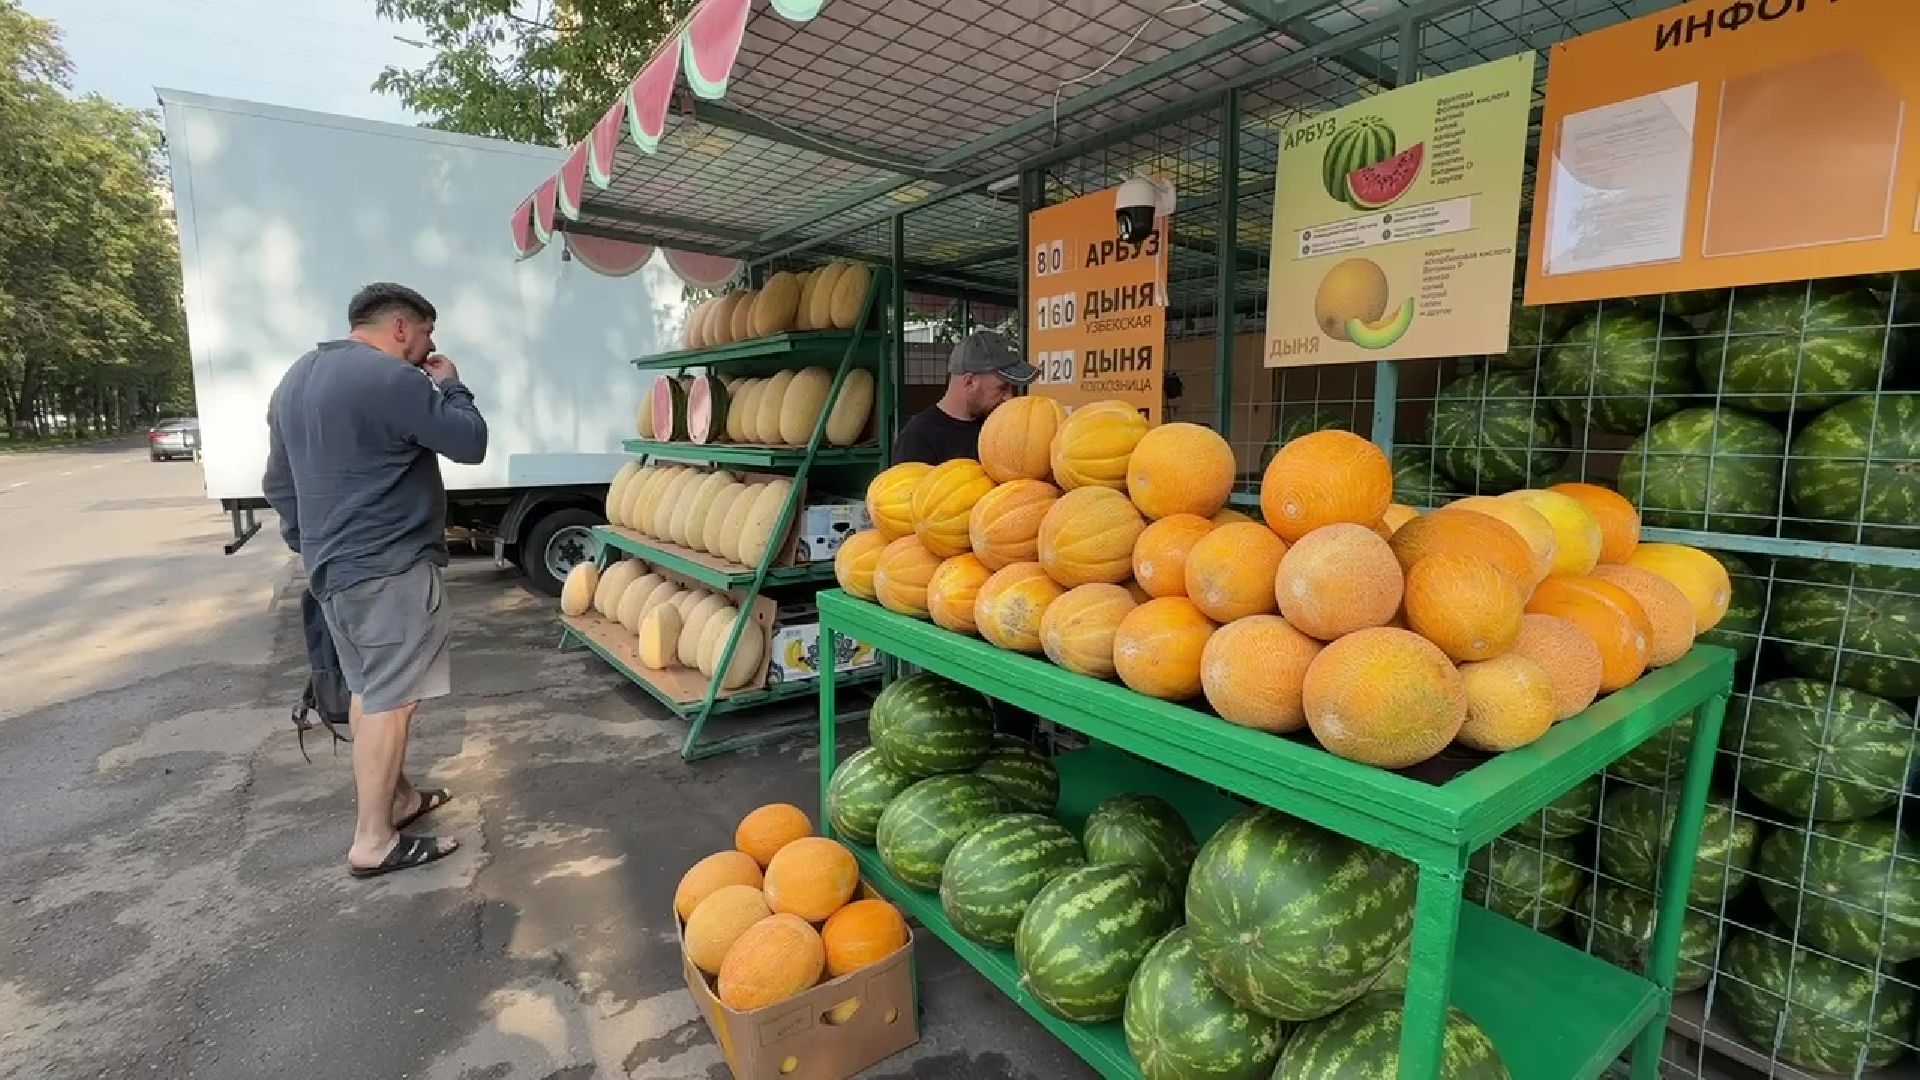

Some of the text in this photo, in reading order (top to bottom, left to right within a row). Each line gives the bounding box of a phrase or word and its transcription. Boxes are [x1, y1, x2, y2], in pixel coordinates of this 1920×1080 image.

[1284, 117, 1336, 151] АРБУЗ
[1037, 231, 1160, 274] 80 АРБУЗ
[1039, 282, 1154, 328] 160 ДЫНЯ
[1085, 314, 1152, 334] УЗБЕКСКАЯ
[1038, 345, 1152, 382] 120 ДЫНЯ
[1269, 336, 1319, 358] ДЫНЯ
[1081, 378, 1153, 394] КОЛХОЗНИЦА
